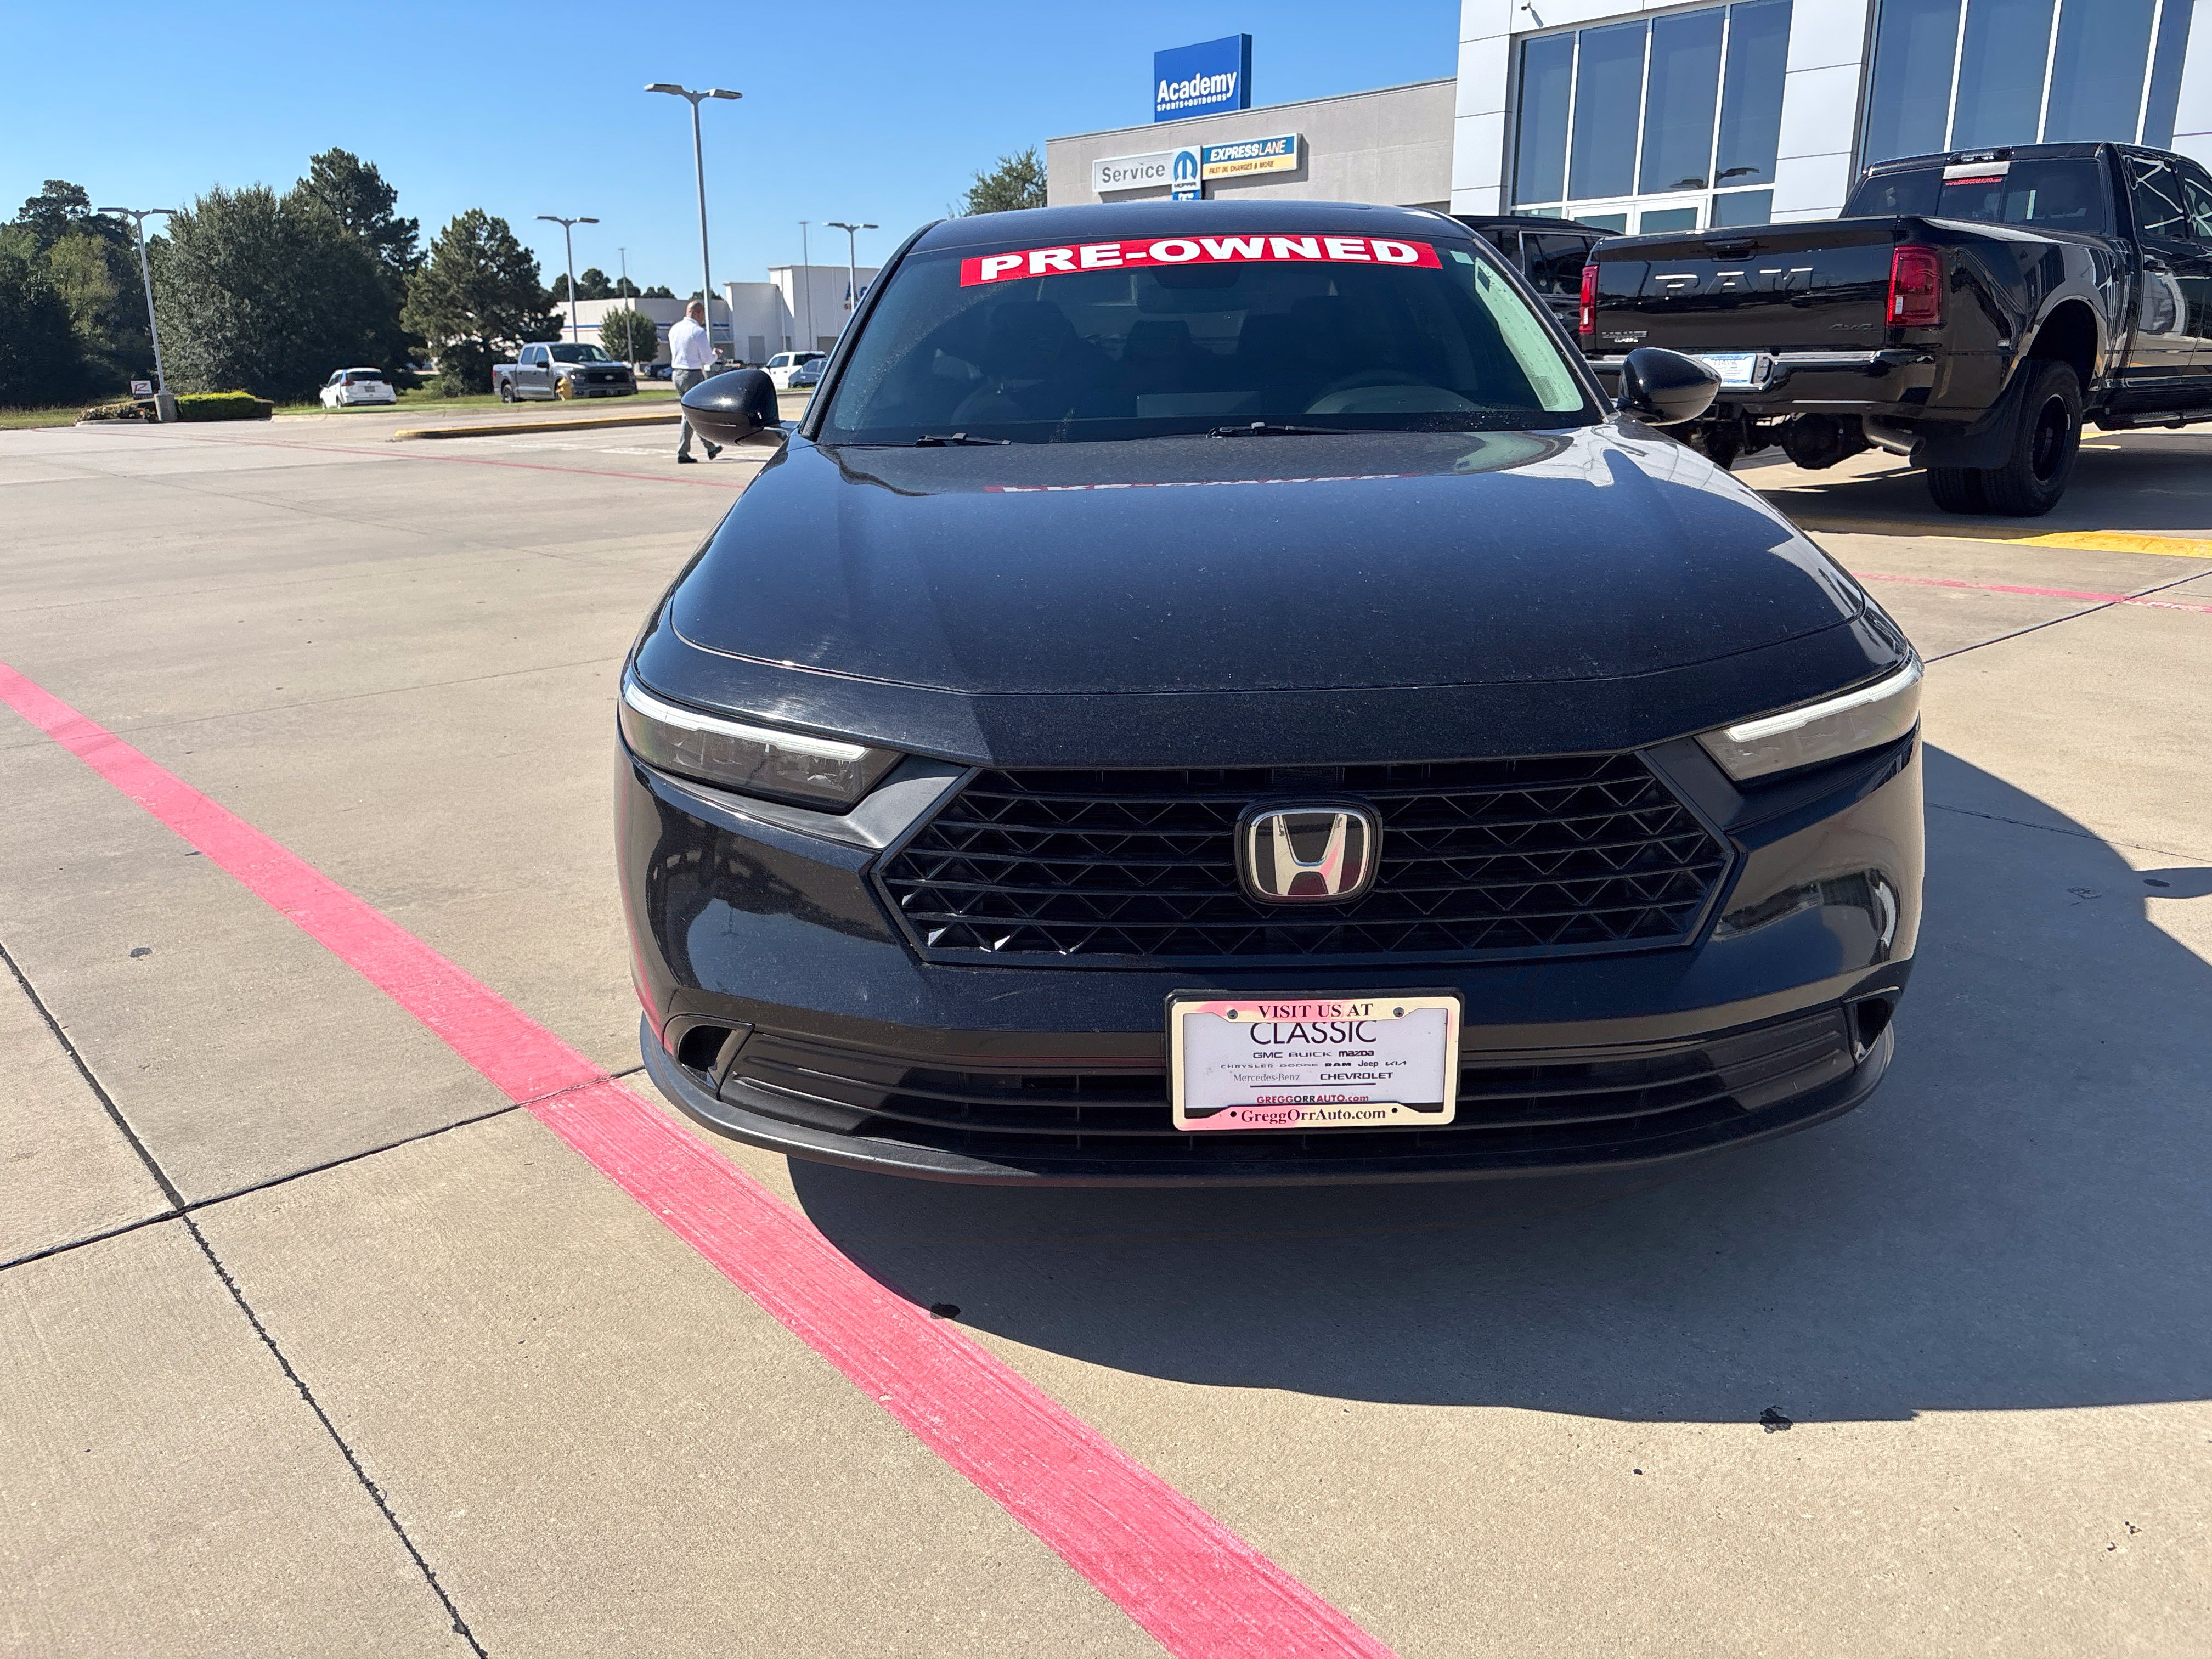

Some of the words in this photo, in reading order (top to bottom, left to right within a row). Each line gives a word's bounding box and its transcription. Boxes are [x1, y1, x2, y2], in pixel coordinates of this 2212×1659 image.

[1157, 71, 1237, 103] Academy
[1102, 162, 1165, 183] Service
[980, 237, 1419, 281] PRE-OWNED
[1258, 1005, 1311, 1018] VISIT
[1318, 1004, 1341, 1018] US
[1348, 1003, 1373, 1017] AT
[1250, 1021, 1377, 1045] CLASSIC
[1358, 1060, 1379, 1068] Jeep
[1233, 1073, 1300, 1082] Mercedes-Benz
[1320, 1071, 1393, 1080] CHEVROLET
[1256, 1094, 1369, 1104] GREGGORRAUTO.com
[1240, 1108, 1387, 1125] GreggOrrAuto.com
